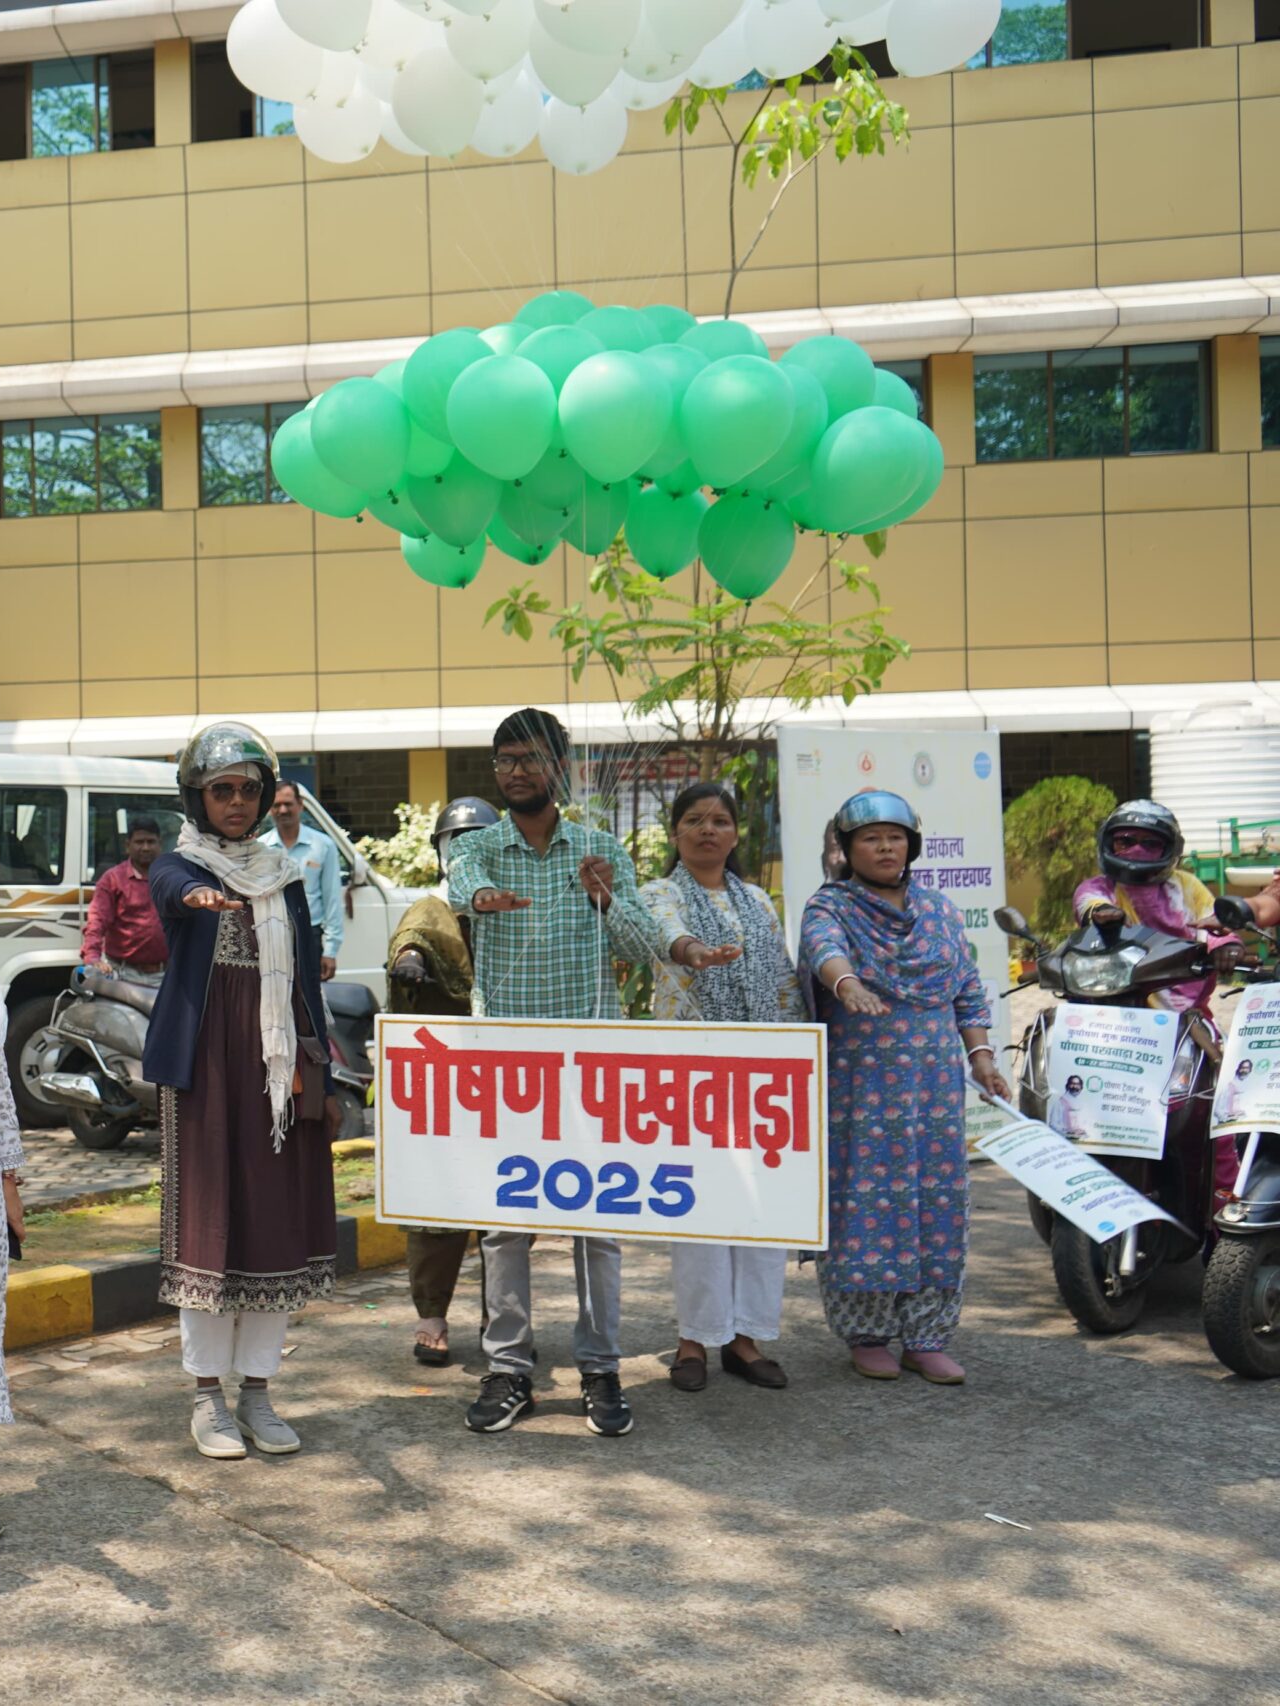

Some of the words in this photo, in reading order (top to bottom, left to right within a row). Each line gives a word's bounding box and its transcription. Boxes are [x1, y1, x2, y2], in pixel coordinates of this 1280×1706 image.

[925, 832, 964, 859] संकल्प
[937, 867, 992, 889] झारखण्ड
[1135, 1051, 1164, 1065] 2025
[385, 1026, 565, 1141] पोषण
[574, 1051, 814, 1169] पखवाड़ा
[496, 1154, 696, 1217] 2025
